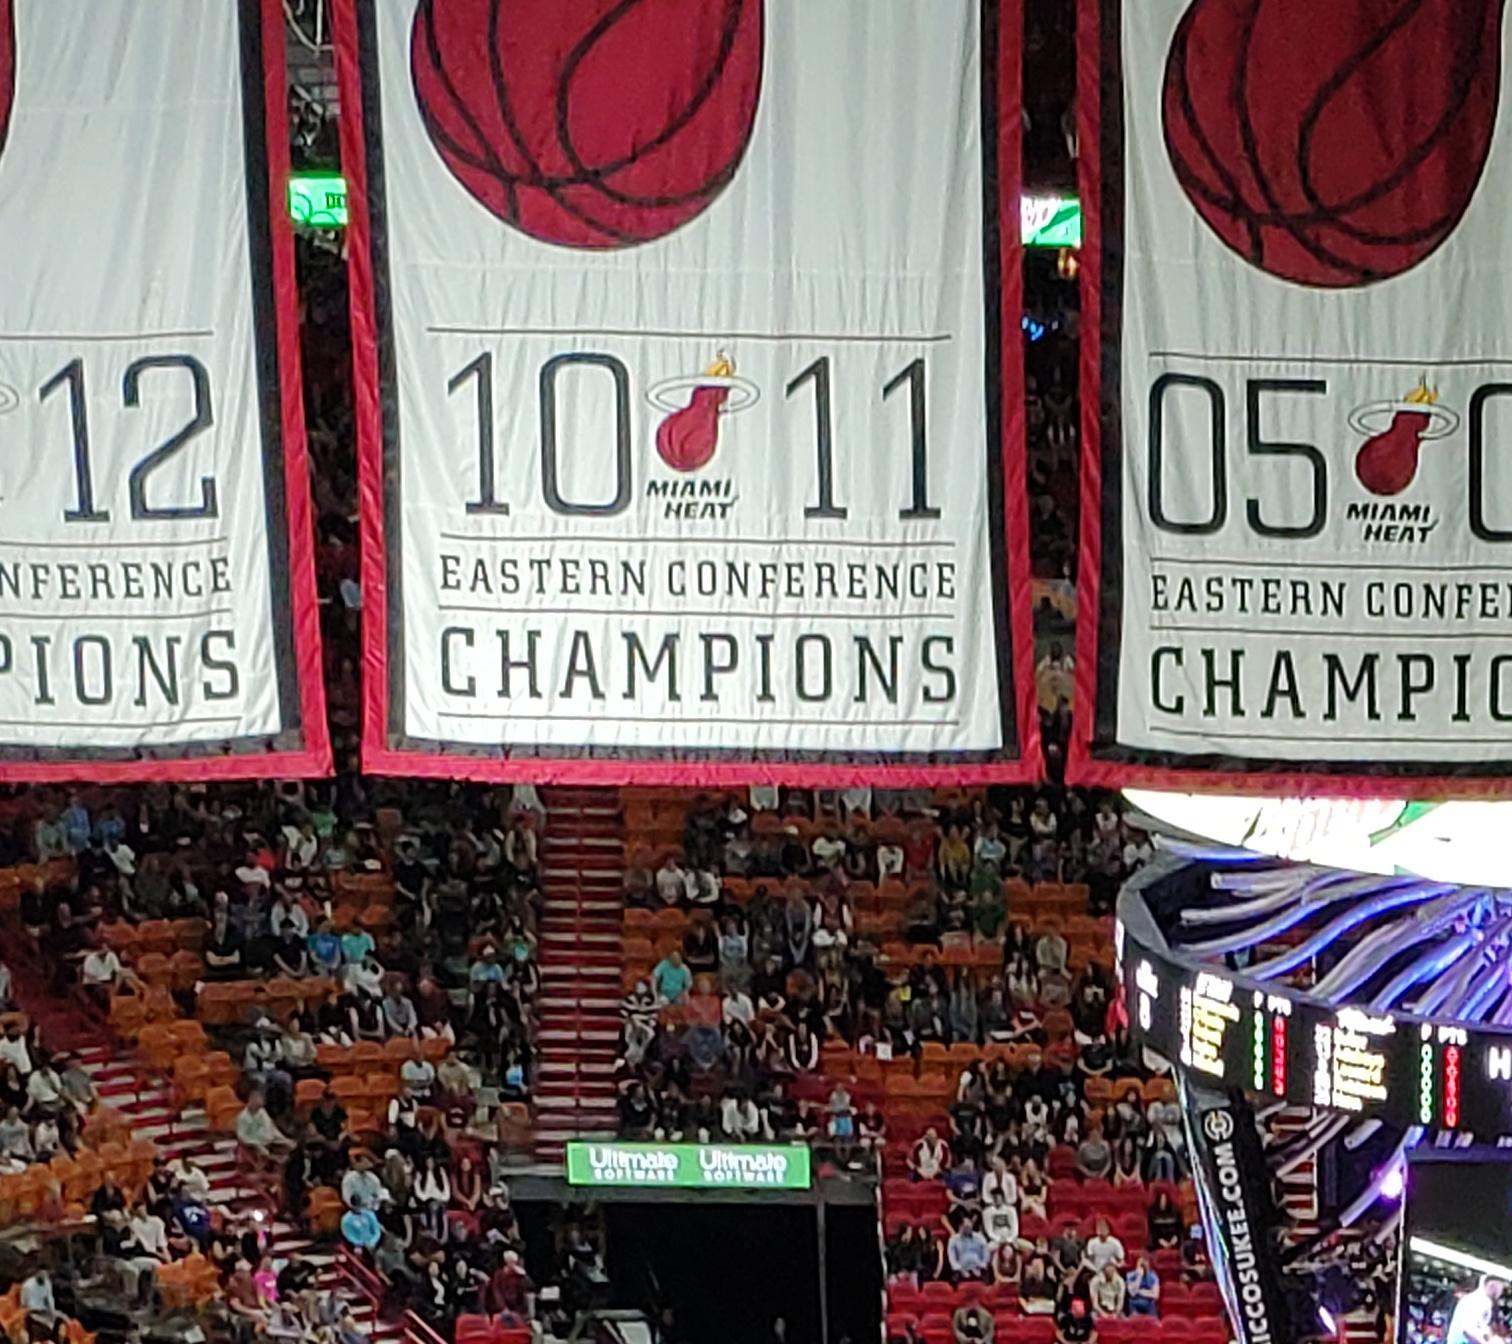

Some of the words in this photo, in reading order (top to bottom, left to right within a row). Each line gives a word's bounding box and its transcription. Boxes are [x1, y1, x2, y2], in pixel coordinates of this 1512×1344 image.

[447, 350, 633, 517] 10
[785, 354, 942, 522] 11
[1147, 373, 1327, 538] 05
[646, 479, 732, 500] MIAMI
[663, 499, 739, 521] HEAT
[1347, 502, 1436, 525] MIAMI
[1362, 522, 1439, 545] HEAT
[440, 554, 647, 598] EASTERN
[667, 557, 956, 600] CONFERENCE
[1151, 574, 1346, 619] EASTERN
[439, 625, 958, 705] CHAMPIONS
[588, 1146, 679, 1171] Ultimate
[699, 1148, 788, 1173] Ultimate
